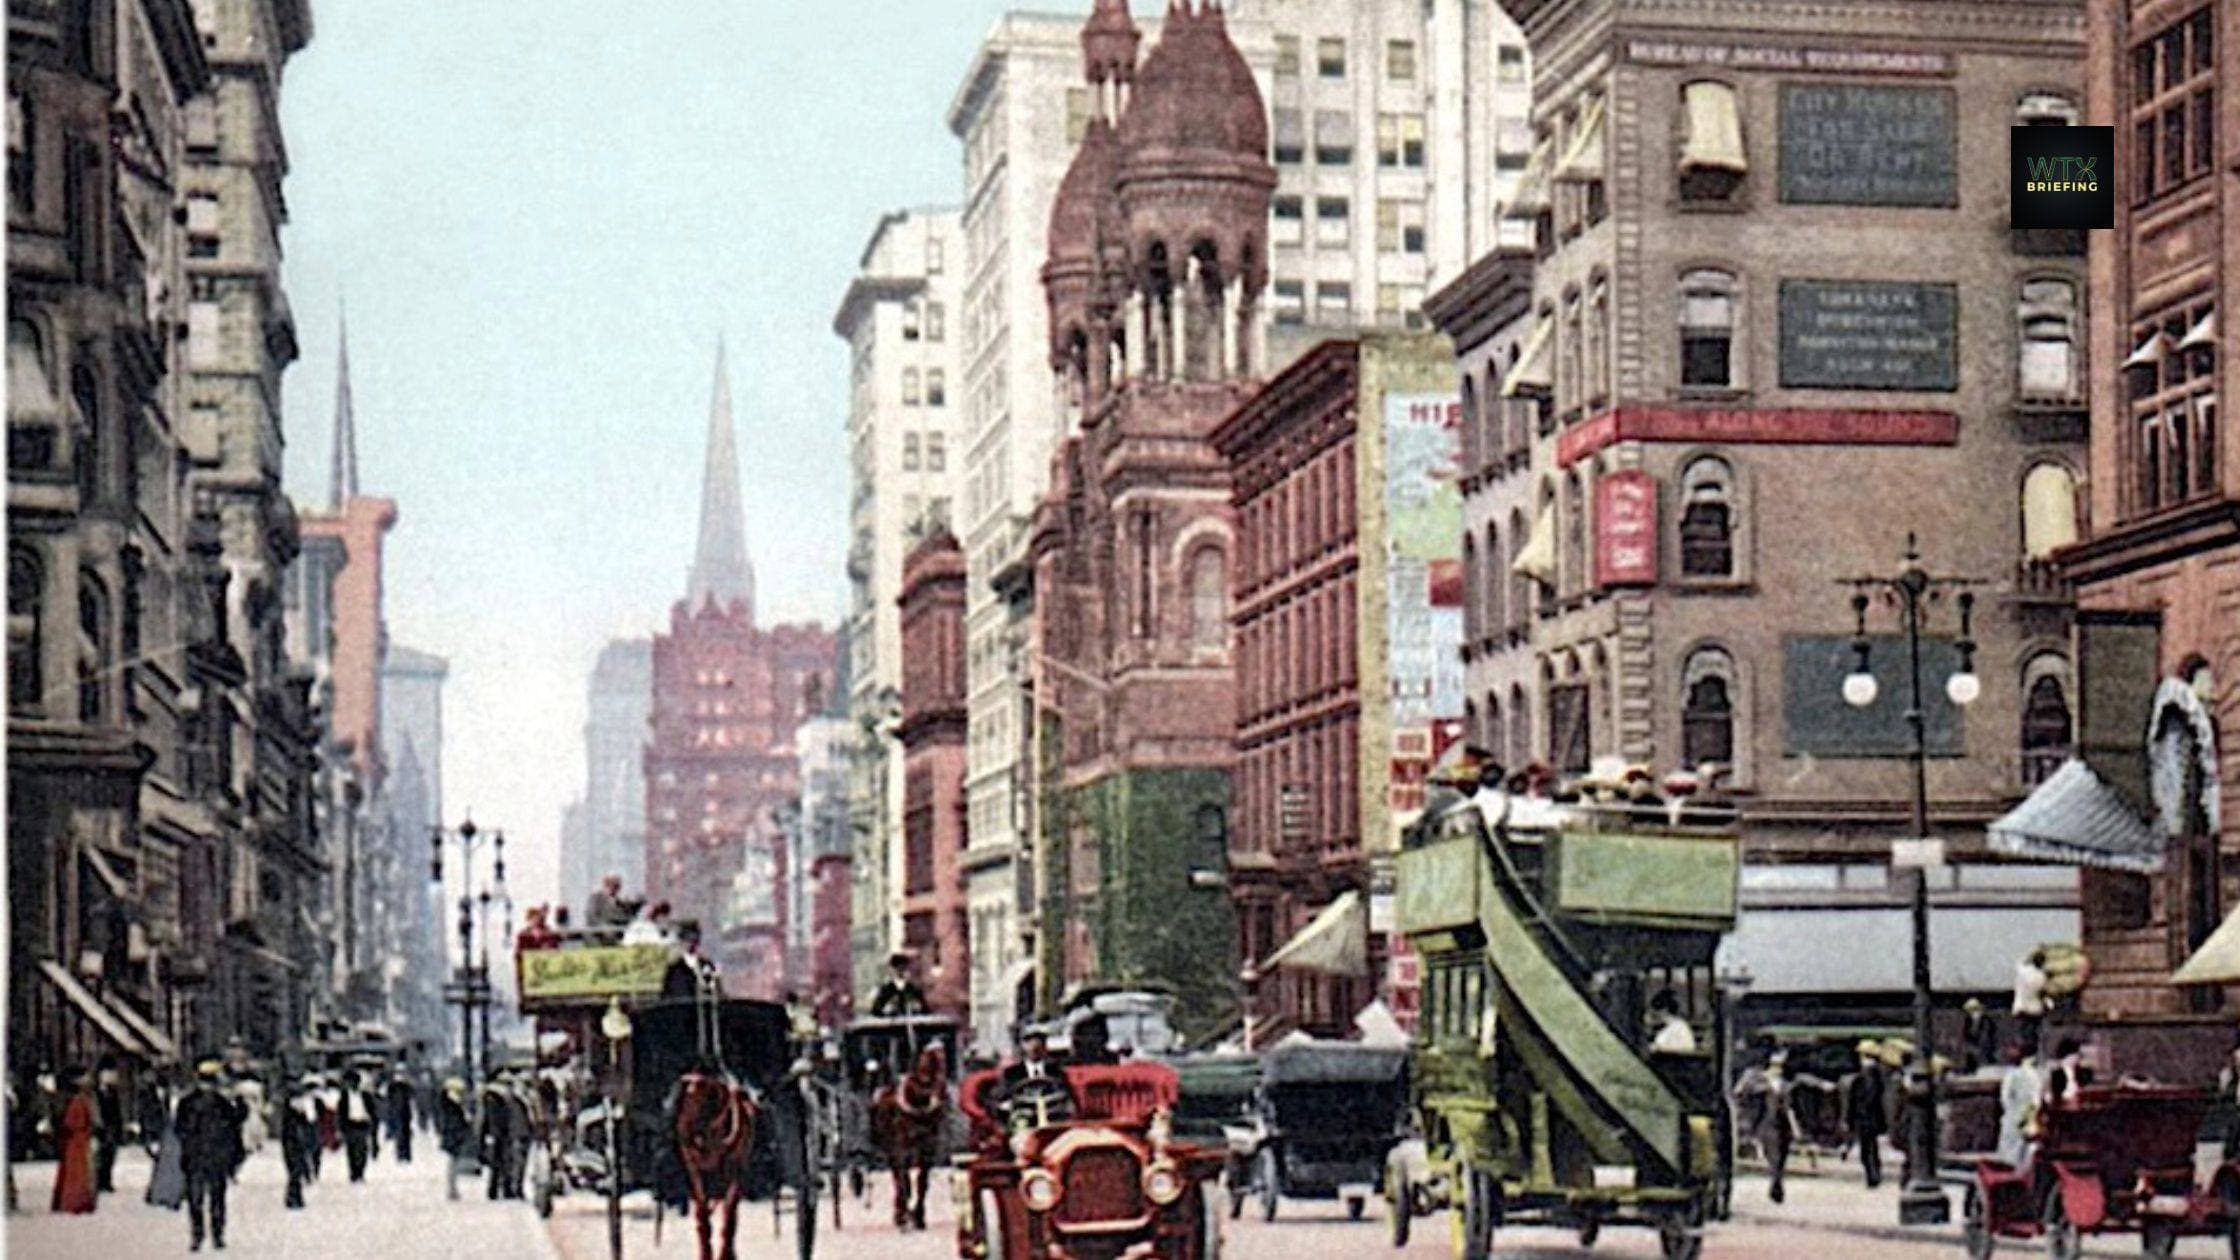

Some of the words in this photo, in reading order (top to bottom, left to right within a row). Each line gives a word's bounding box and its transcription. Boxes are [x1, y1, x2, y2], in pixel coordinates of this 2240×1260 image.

[1629, 42, 1701, 63] BUREAU
[1705, 47, 1729, 64] OF
[1733, 48, 1801, 67] SOCIAL
